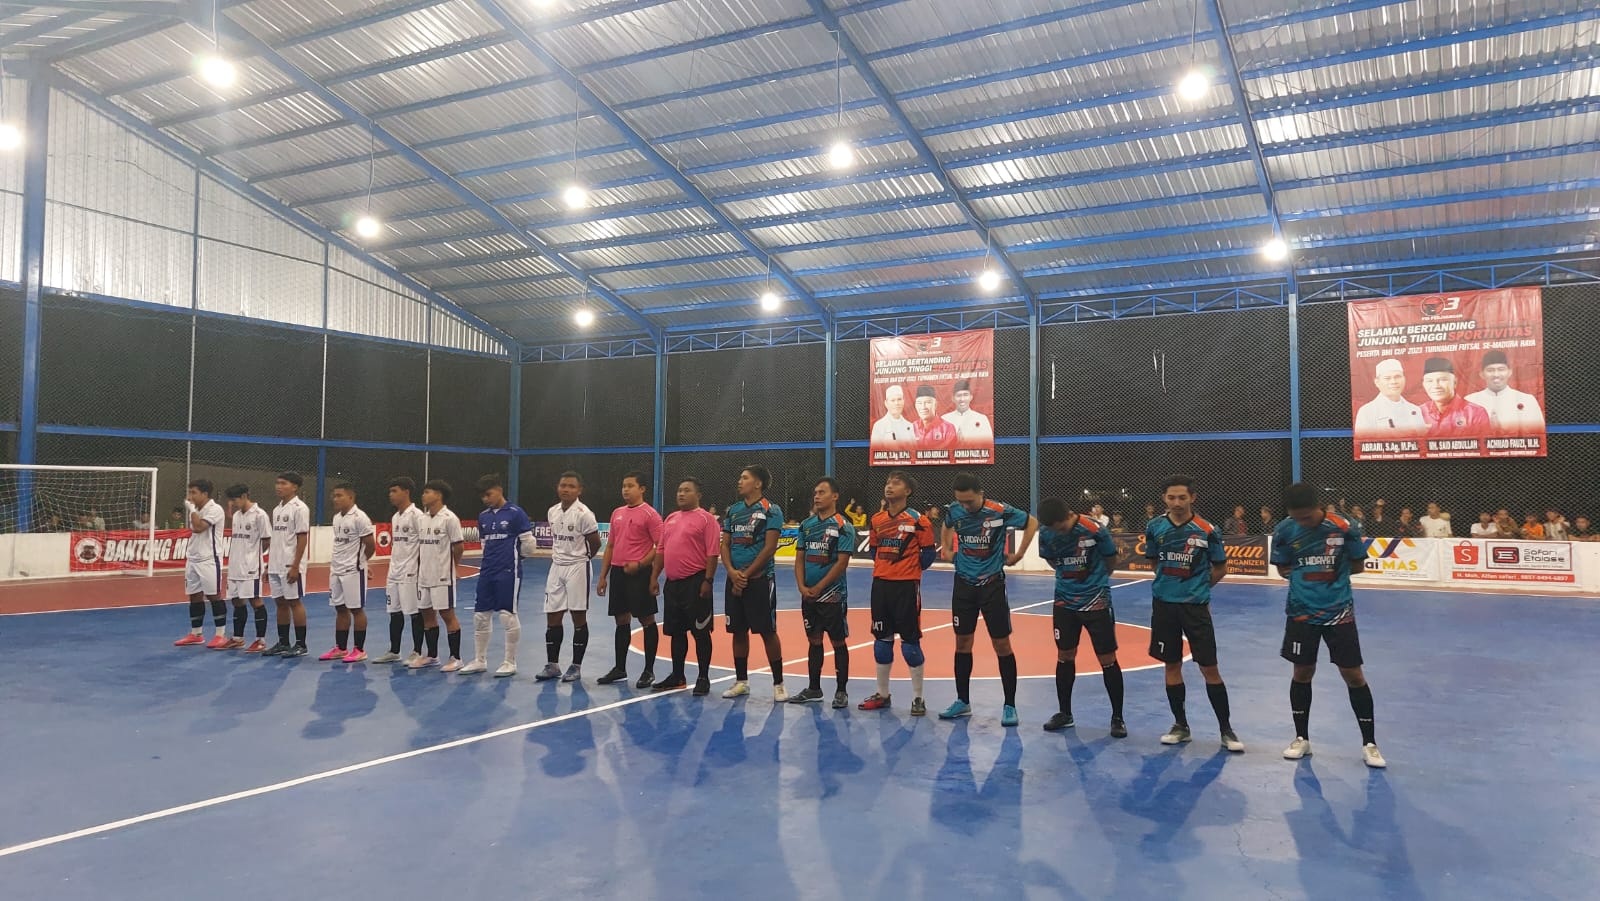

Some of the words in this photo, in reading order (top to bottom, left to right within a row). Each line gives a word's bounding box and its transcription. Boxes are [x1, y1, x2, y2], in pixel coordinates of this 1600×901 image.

[1443, 296, 1460, 310] 3
[1357, 326, 1406, 339] SELAMAT
[1407, 320, 1476, 334] BERTANDING
[1357, 335, 1407, 348] JUNJUNG
[1409, 331, 1447, 343] TINGGI
[1449, 325, 1533, 341] SPORTIVITAS
[1458, 342, 1481, 352] FUTSAL
[875, 359, 906, 370] SELAMAT
[906, 355, 952, 367] BERTANDING
[875, 366, 908, 376] JUNJUNG
[908, 364, 932, 373] TINGGI
[1451, 439, 1478, 450] ABDULLAH
[1364, 559, 1379, 570] ai
[1382, 560, 1418, 572] MAS
[1523, 555, 1566, 564] Etalase
[953, 616, 960, 627] 9
[1158, 641, 1165, 653] 7
[1292, 641, 1302, 655] 11
